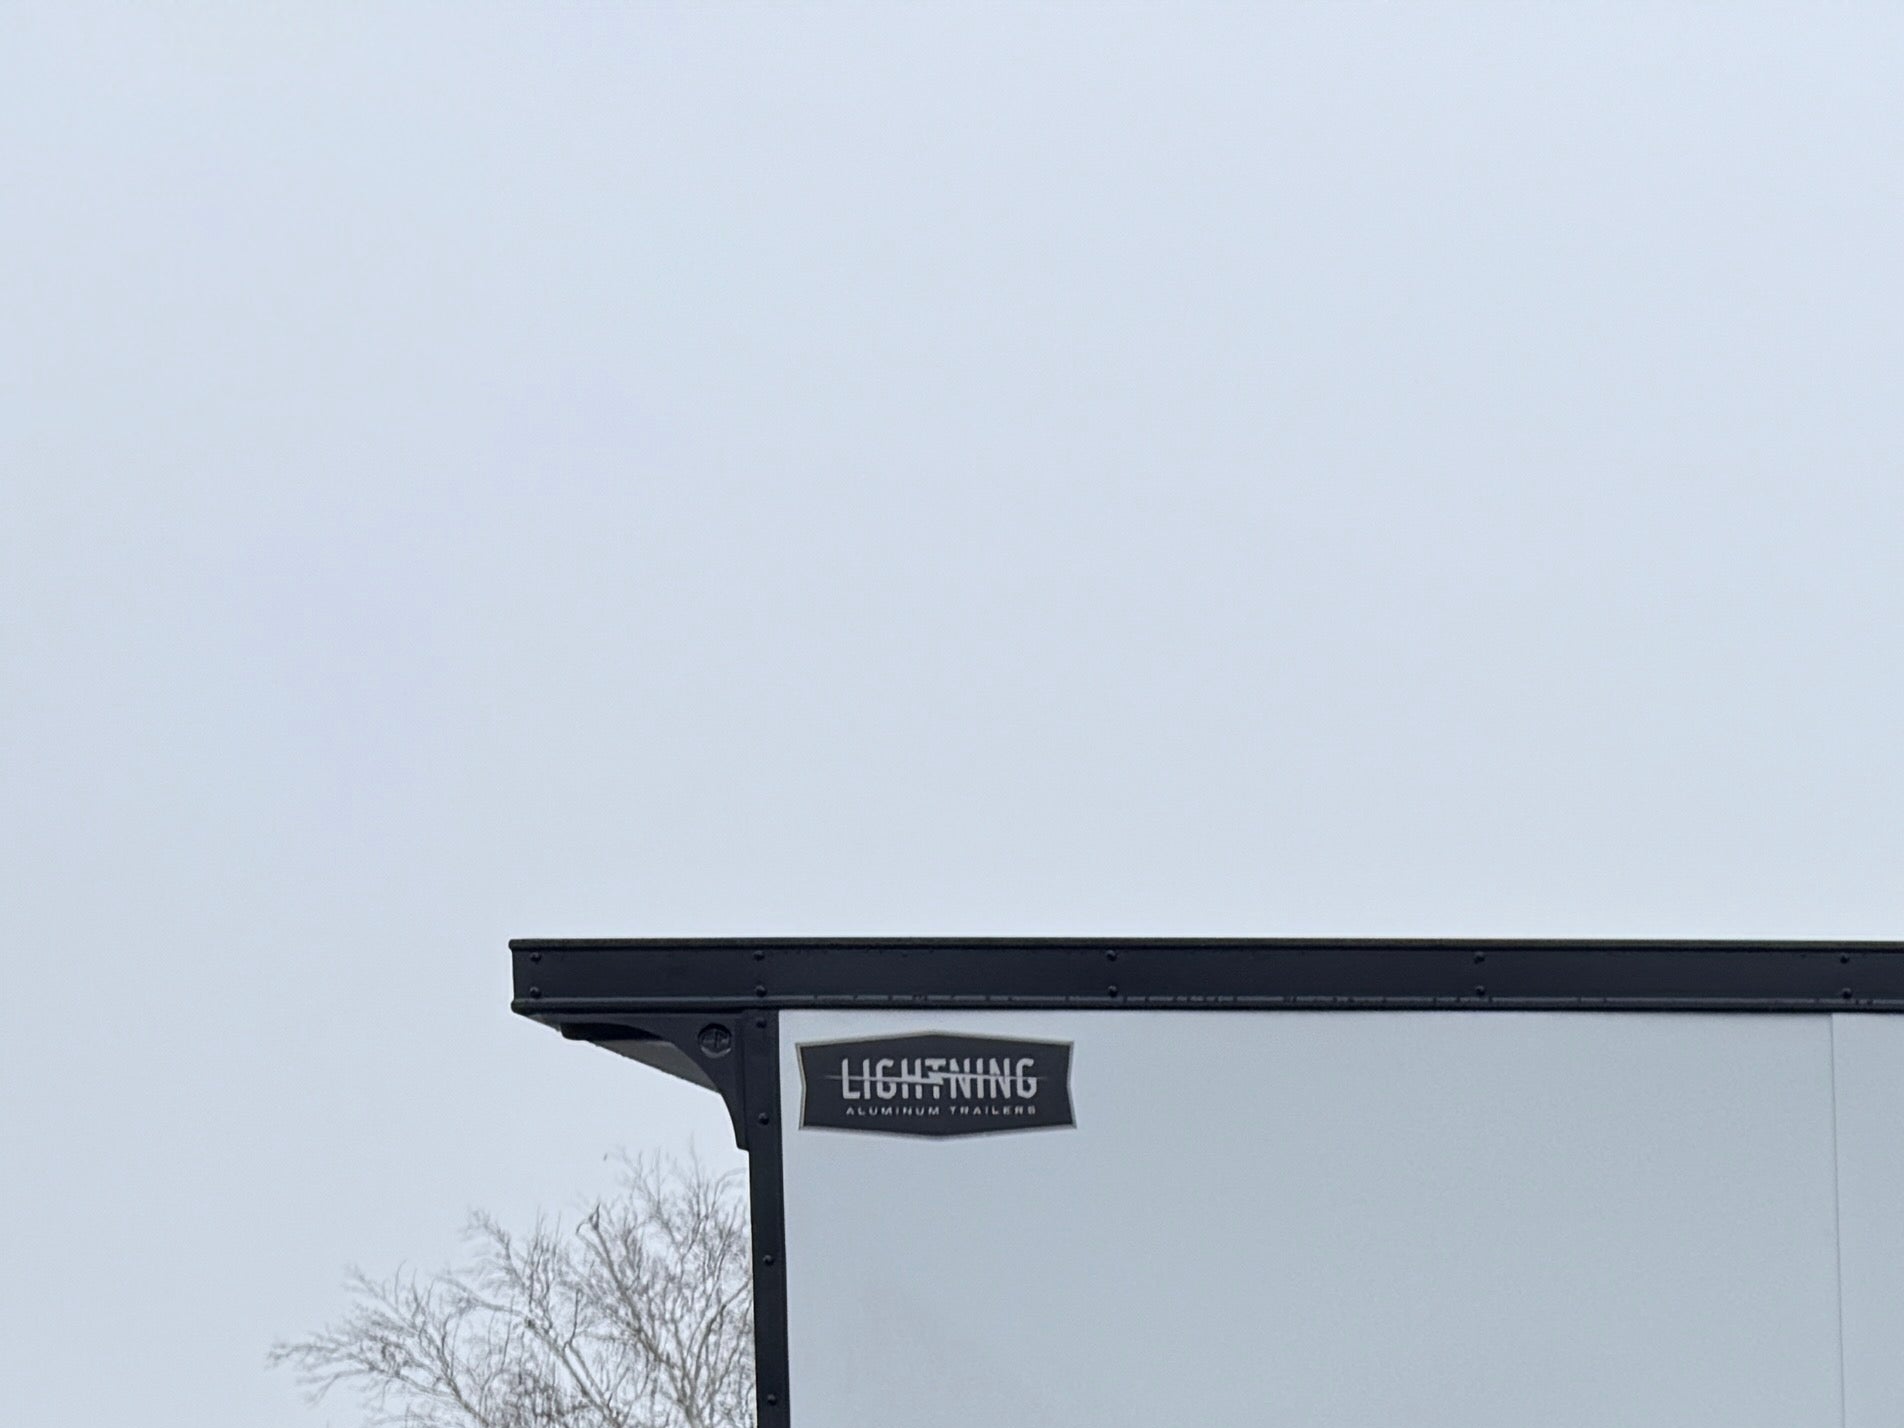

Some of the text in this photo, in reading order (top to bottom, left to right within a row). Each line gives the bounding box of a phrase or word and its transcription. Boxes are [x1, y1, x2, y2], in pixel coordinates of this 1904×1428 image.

[841, 1057, 1038, 1100] LIGHTNING
[846, 1105, 1037, 1116] ALUMINUM TRAILERS
